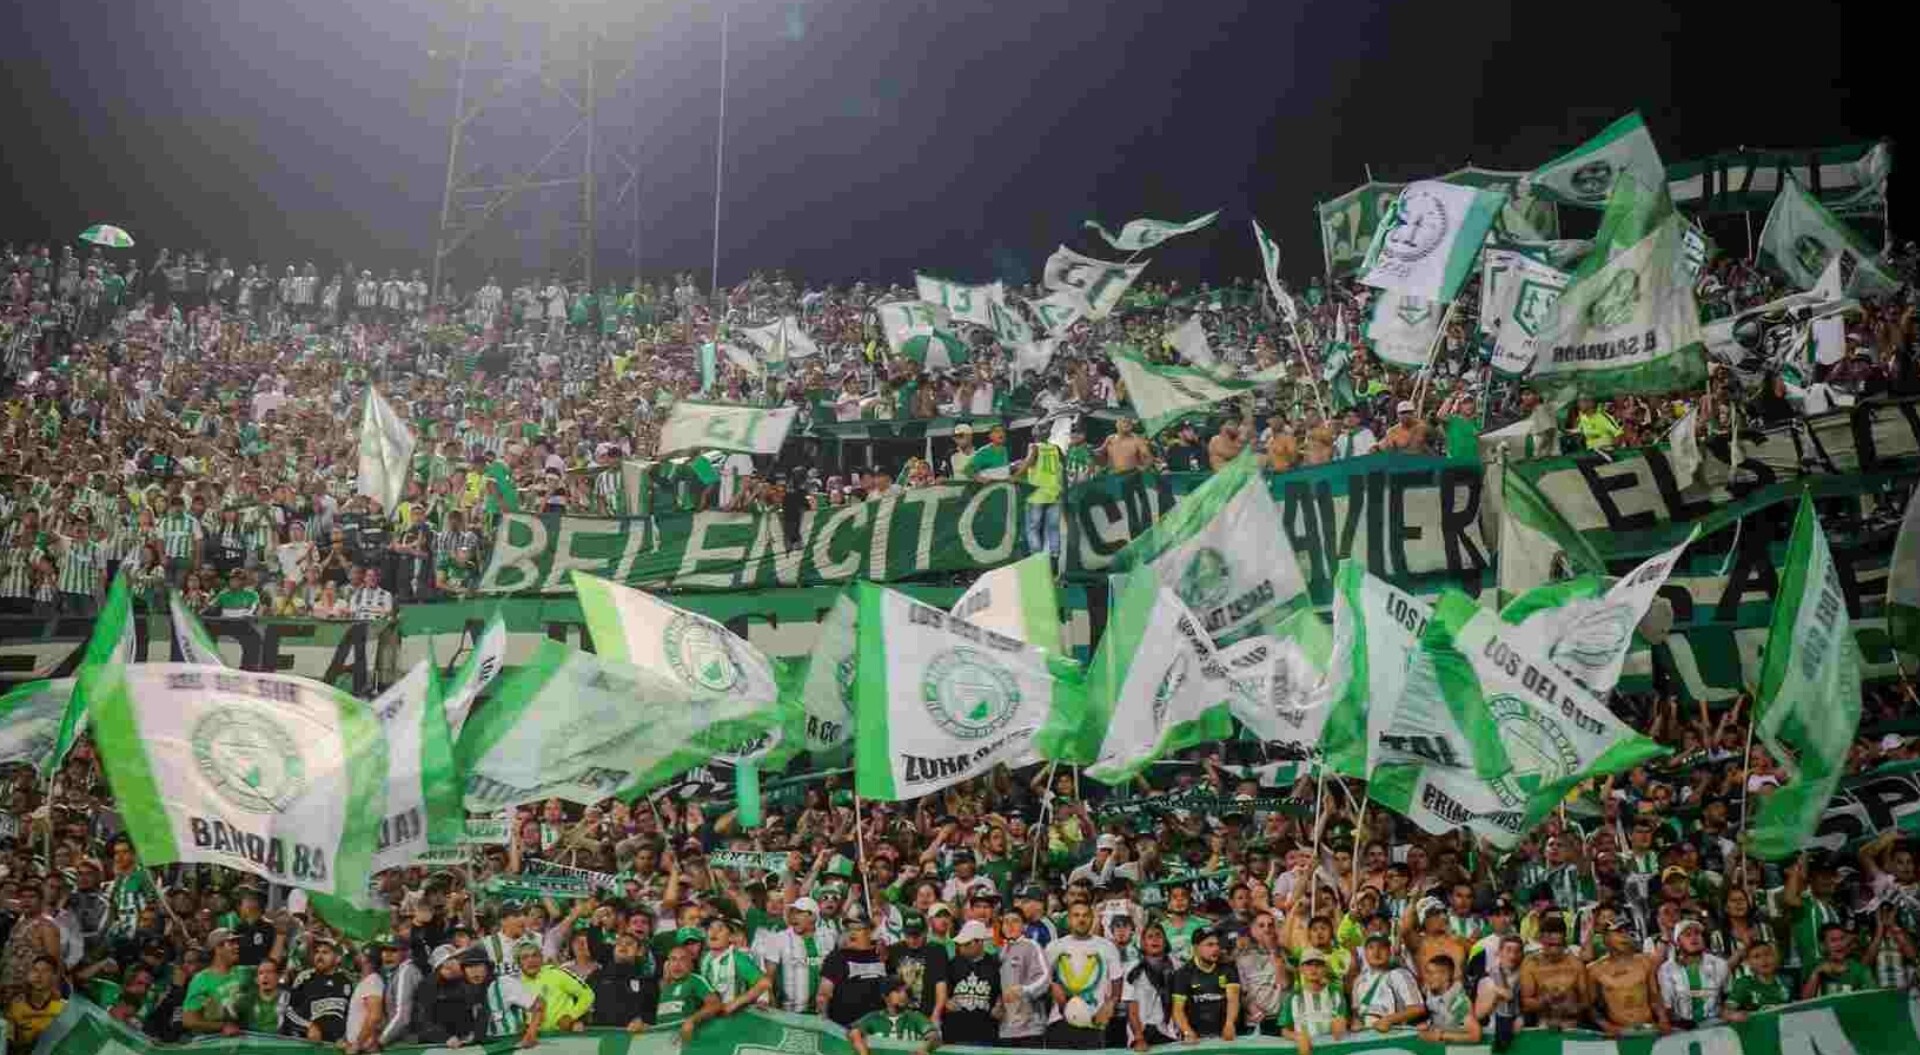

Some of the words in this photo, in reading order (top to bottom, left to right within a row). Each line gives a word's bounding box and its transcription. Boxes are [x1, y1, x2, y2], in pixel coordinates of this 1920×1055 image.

[1283, 467, 1482, 600] AVIER
[1384, 591, 1418, 632] LOS
[1483, 634, 1520, 678] LOS
[191, 817, 285, 875] BANDA
